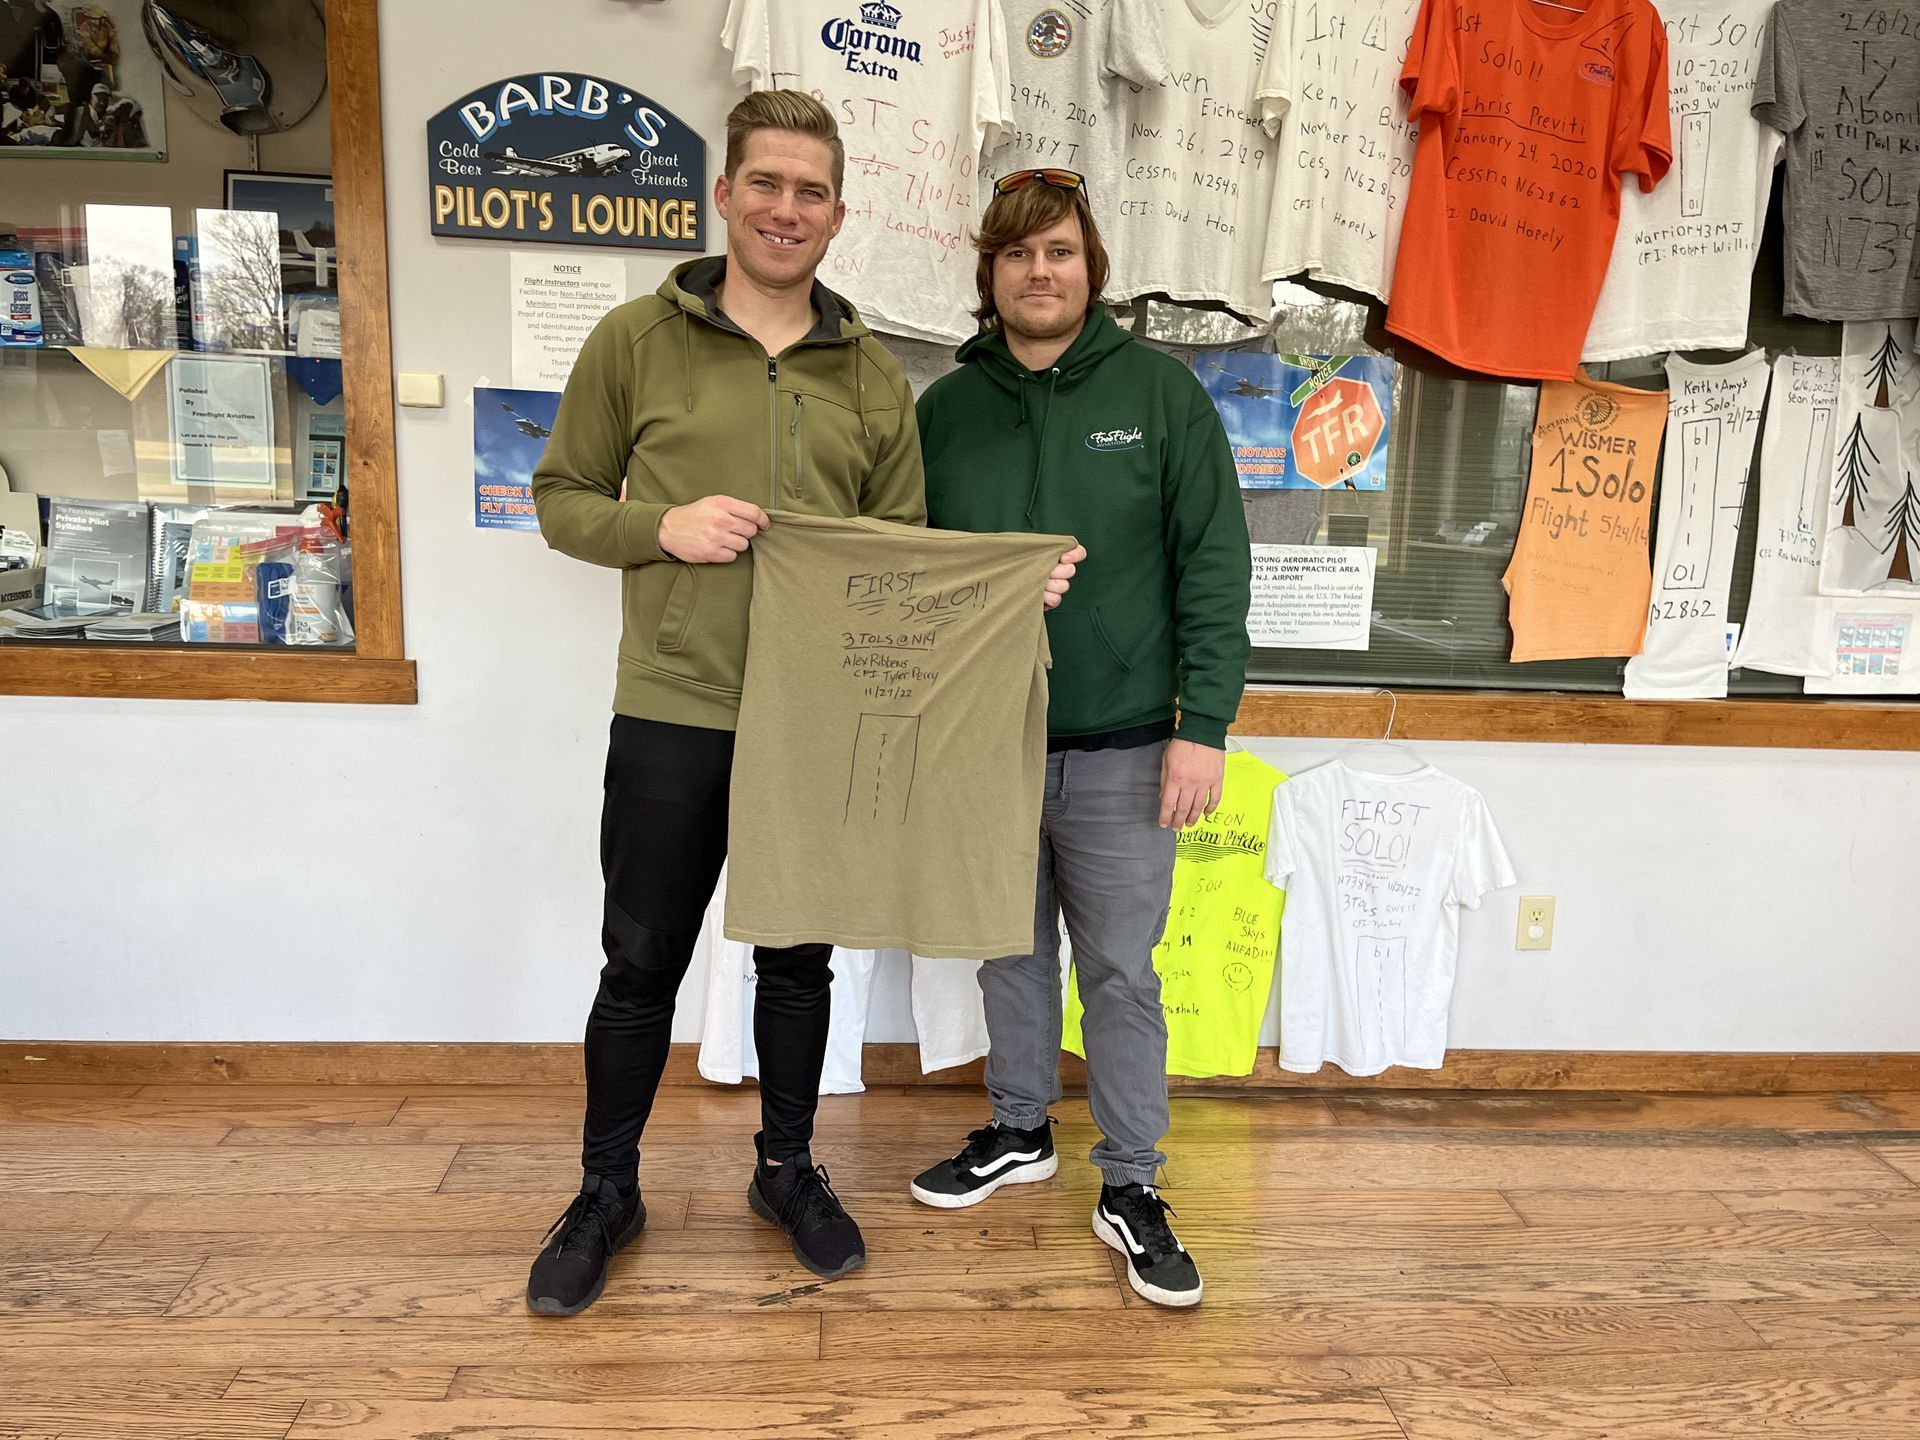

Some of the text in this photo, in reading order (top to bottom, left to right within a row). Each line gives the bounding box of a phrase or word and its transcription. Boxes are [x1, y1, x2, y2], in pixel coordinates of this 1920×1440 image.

[1664, 14, 1702, 43] rst
[821, 18, 922, 64] Corona
[845, 51, 899, 82] Extra
[458, 75, 667, 150] BARB'S
[1066, 102, 1097, 128] 2020
[439, 140, 479, 159] Cold
[639, 149, 679, 169] Great
[1453, 127, 1513, 152] January
[1551, 153, 1598, 180] 2020
[439, 158, 482, 176] Beer
[1126, 158, 1178, 182] Cessna
[1445, 157, 1507, 187] Cessna
[631, 167, 688, 188] Friends
[906, 171, 971, 212] 7/10/22
[434, 184, 698, 240] PILOT'S LOUNGE
[1469, 207, 1508, 228] David
[553, 265, 582, 274] NOTICE
[524, 277, 544, 286] Flight
[544, 278, 580, 288] Instructors
[581, 281, 599, 290] using
[519, 288, 617, 301] Facilities for Non-Flight School
[526, 300, 557, 309] Members
[558, 302, 576, 310] must
[576, 303, 601, 312] provide
[518, 310, 536, 319] Proof
[545, 312, 581, 322] Citizenship
[541, 323, 584, 332] Identification
[534, 334, 577, 344] students, per
[551, 359, 571, 367] Thank
[1298, 356, 1319, 370] SHORT
[1308, 364, 1334, 390] NOTICE
[1684, 380, 1712, 395] Keith
[1301, 403, 1369, 464] TFR
[1559, 427, 1637, 457] WISMER
[1237, 447, 1287, 458] NOTAMS
[1576, 455, 1647, 504] Solo
[479, 485, 523, 498] CHECK
[480, 502, 503, 513] FLY
[55, 521, 93, 533] Syllabus
[56, 513, 110, 527] Private Pilot
[1530, 497, 1591, 540] Flight
[1253, 556, 1281, 564] YOUNG
[1282, 556, 1325, 564] AEROBATIC
[846, 571, 929, 599] FIRST
[0, 590, 32, 604] ACCESSORIES
[842, 653, 868, 668] Alex
[1341, 799, 1432, 827] FIRST
[1223, 829, 1266, 853] Pride
[1233, 907, 1260, 925] BLUE
